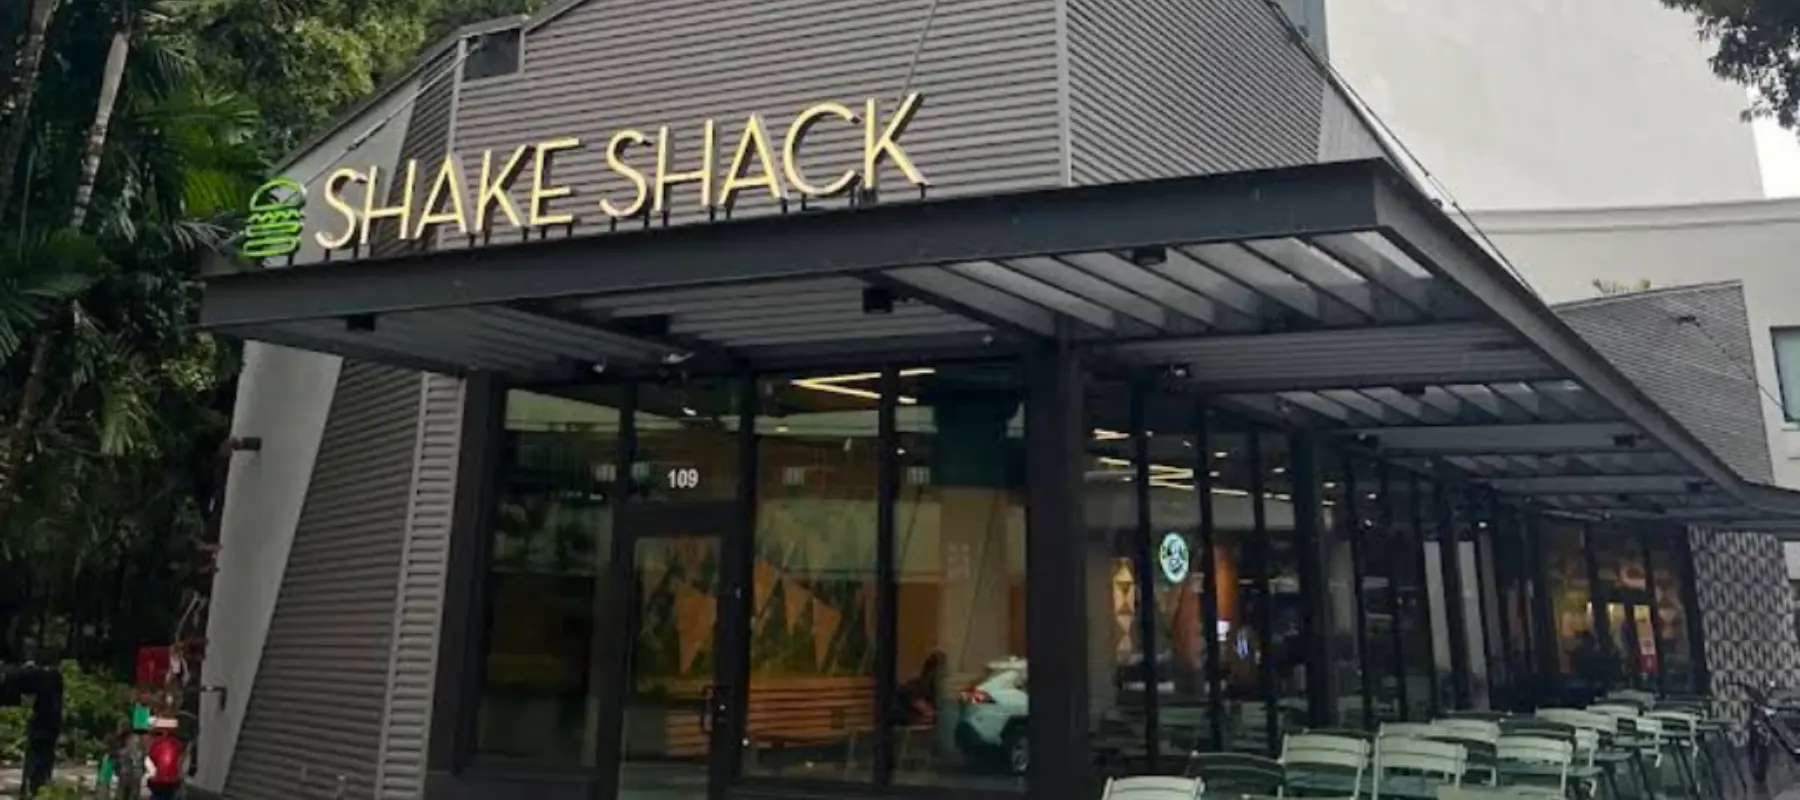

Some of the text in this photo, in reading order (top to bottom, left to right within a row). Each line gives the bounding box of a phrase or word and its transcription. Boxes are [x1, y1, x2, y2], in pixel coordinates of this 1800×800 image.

[314, 91, 928, 249] SHAKE SHACK
[667, 467, 700, 489] 109
